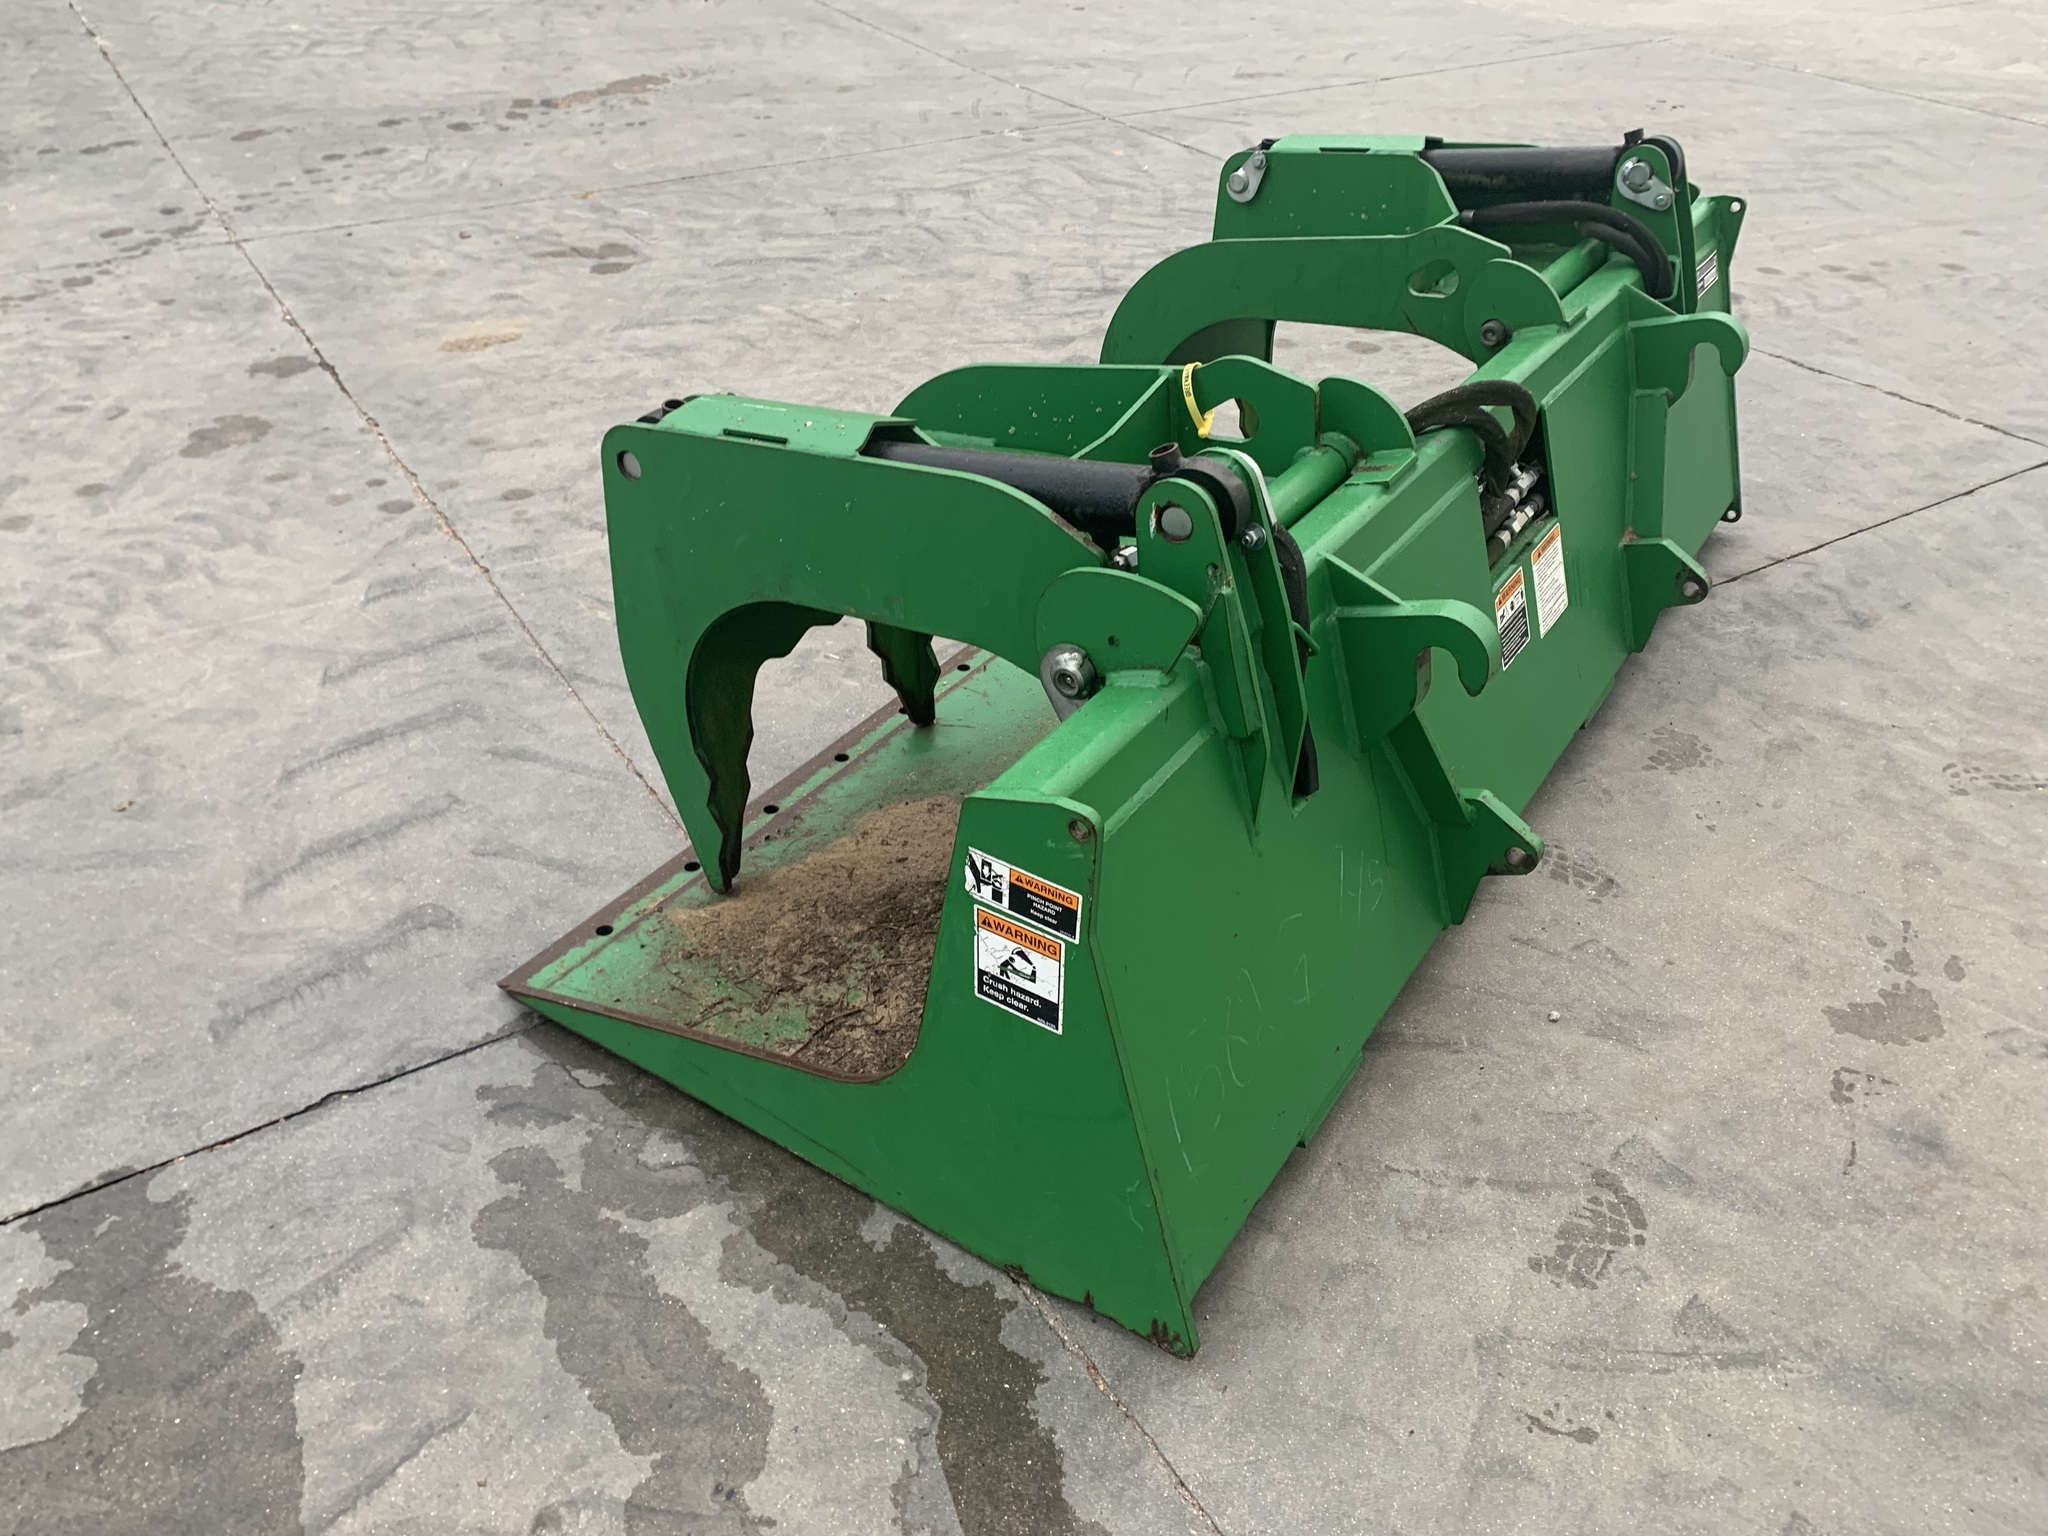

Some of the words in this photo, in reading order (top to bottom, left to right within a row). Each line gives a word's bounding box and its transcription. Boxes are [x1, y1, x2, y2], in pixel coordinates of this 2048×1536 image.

[1502, 574, 1522, 601] WARNING
[1024, 881, 1073, 905] WARNING
[1026, 893, 1045, 905] PINCH
[1045, 901, 1062, 913] POINT
[1030, 908, 1043, 919] Keep
[1033, 902, 1055, 916] HAZARD
[993, 920, 1057, 956] WARNING
[983, 975, 1008, 992] Crush
[1011, 986, 1041, 1008] hazard.
[983, 985, 1004, 1001] Keep
[1006, 996, 1029, 1012] clear.
